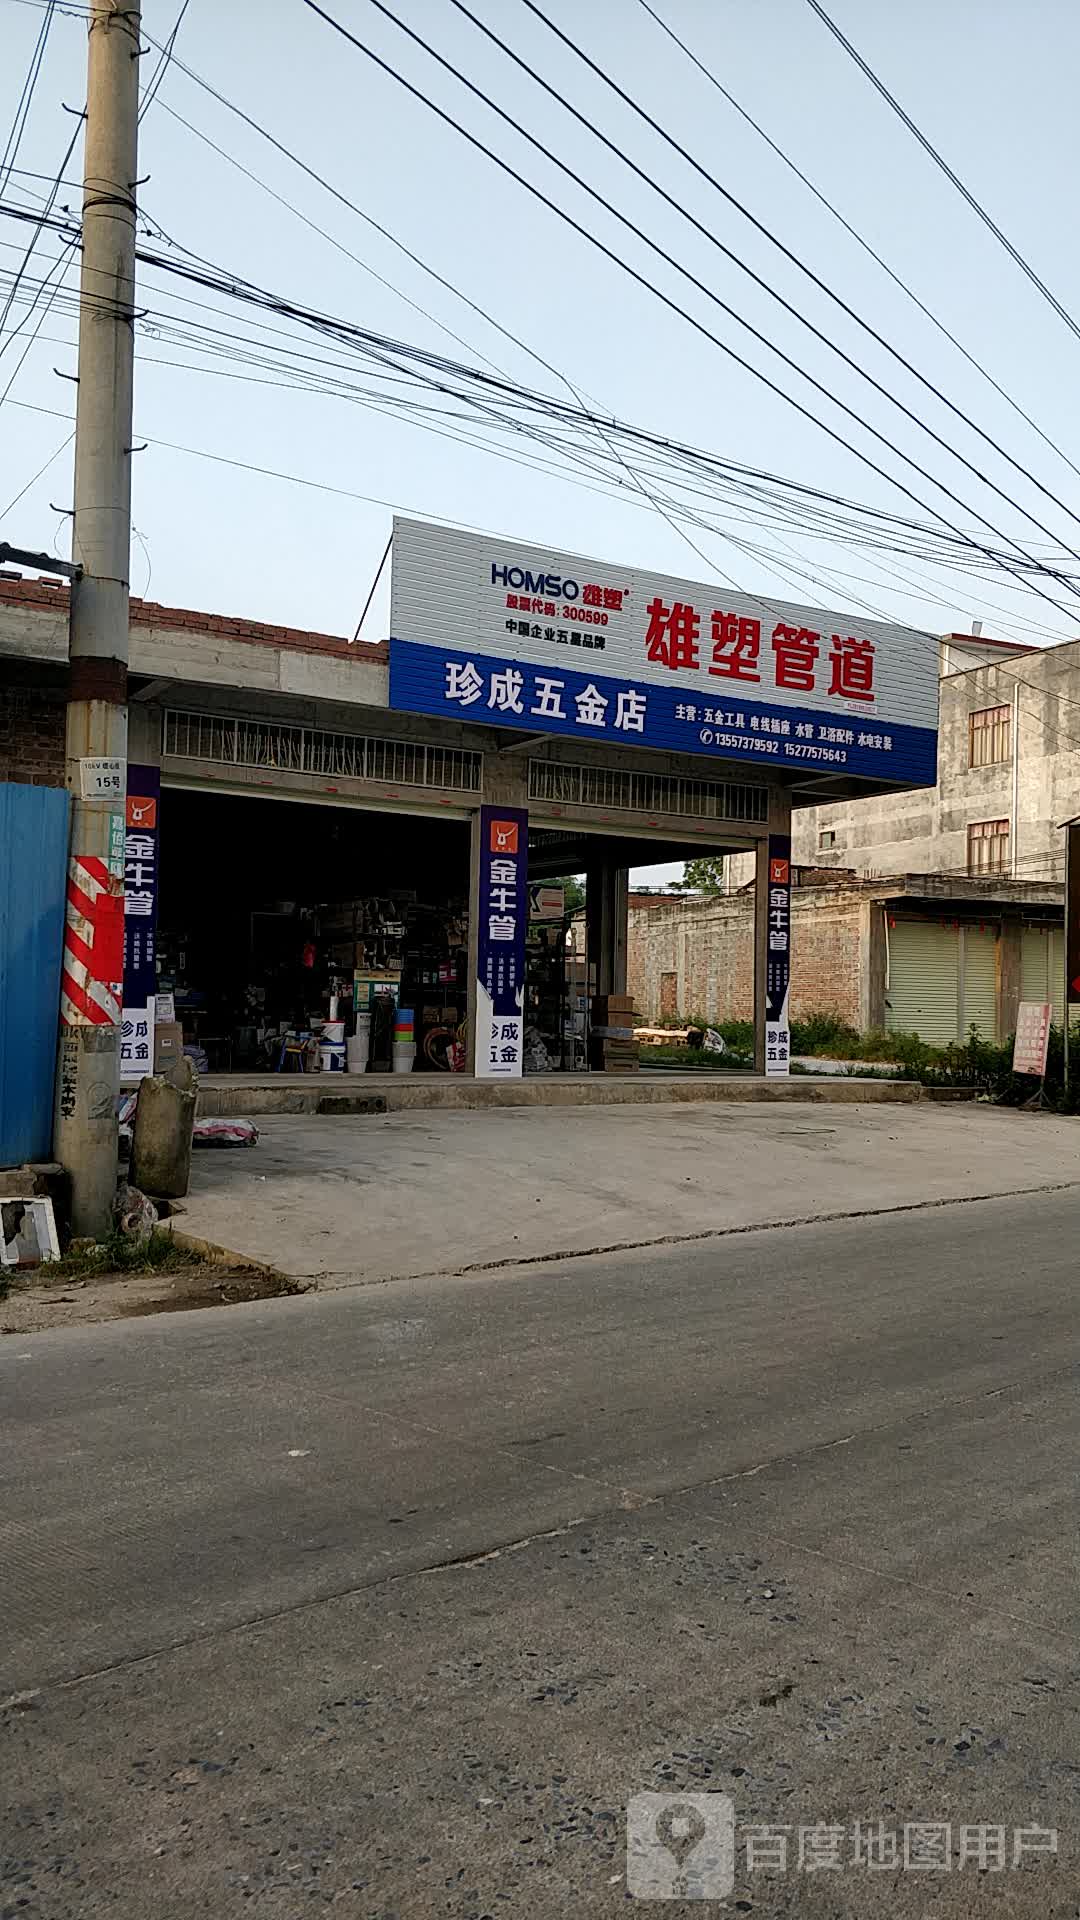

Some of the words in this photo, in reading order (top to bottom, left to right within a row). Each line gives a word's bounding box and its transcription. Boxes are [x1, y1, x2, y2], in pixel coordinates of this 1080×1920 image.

[491, 562, 579, 600] HOMSO
[582, 584, 623, 611] 雄塑
[505, 619, 606, 650] 中国企业五星品牌
[645, 597, 875, 701] 雄塑管道
[445, 662, 647, 732] 珍成五金店
[714, 732, 779, 753] 13557379592
[784, 743, 847, 763] 15277575643
[750, 716, 791, 735] 电线插座
[795, 723, 814, 738] 水管
[817, 726, 854, 745] 卫浴配件
[858, 732, 893, 751] 水电安装
[95, 776, 121, 789] 15号
[123, 834, 155, 915] 金牛管
[489, 859, 518, 941] 金牛管
[769, 888, 788, 951] 金牛管
[121, 1042, 149, 1059] 五金
[767, 1031, 788, 1044] 珍成
[767, 1047, 788, 1061] 五金
